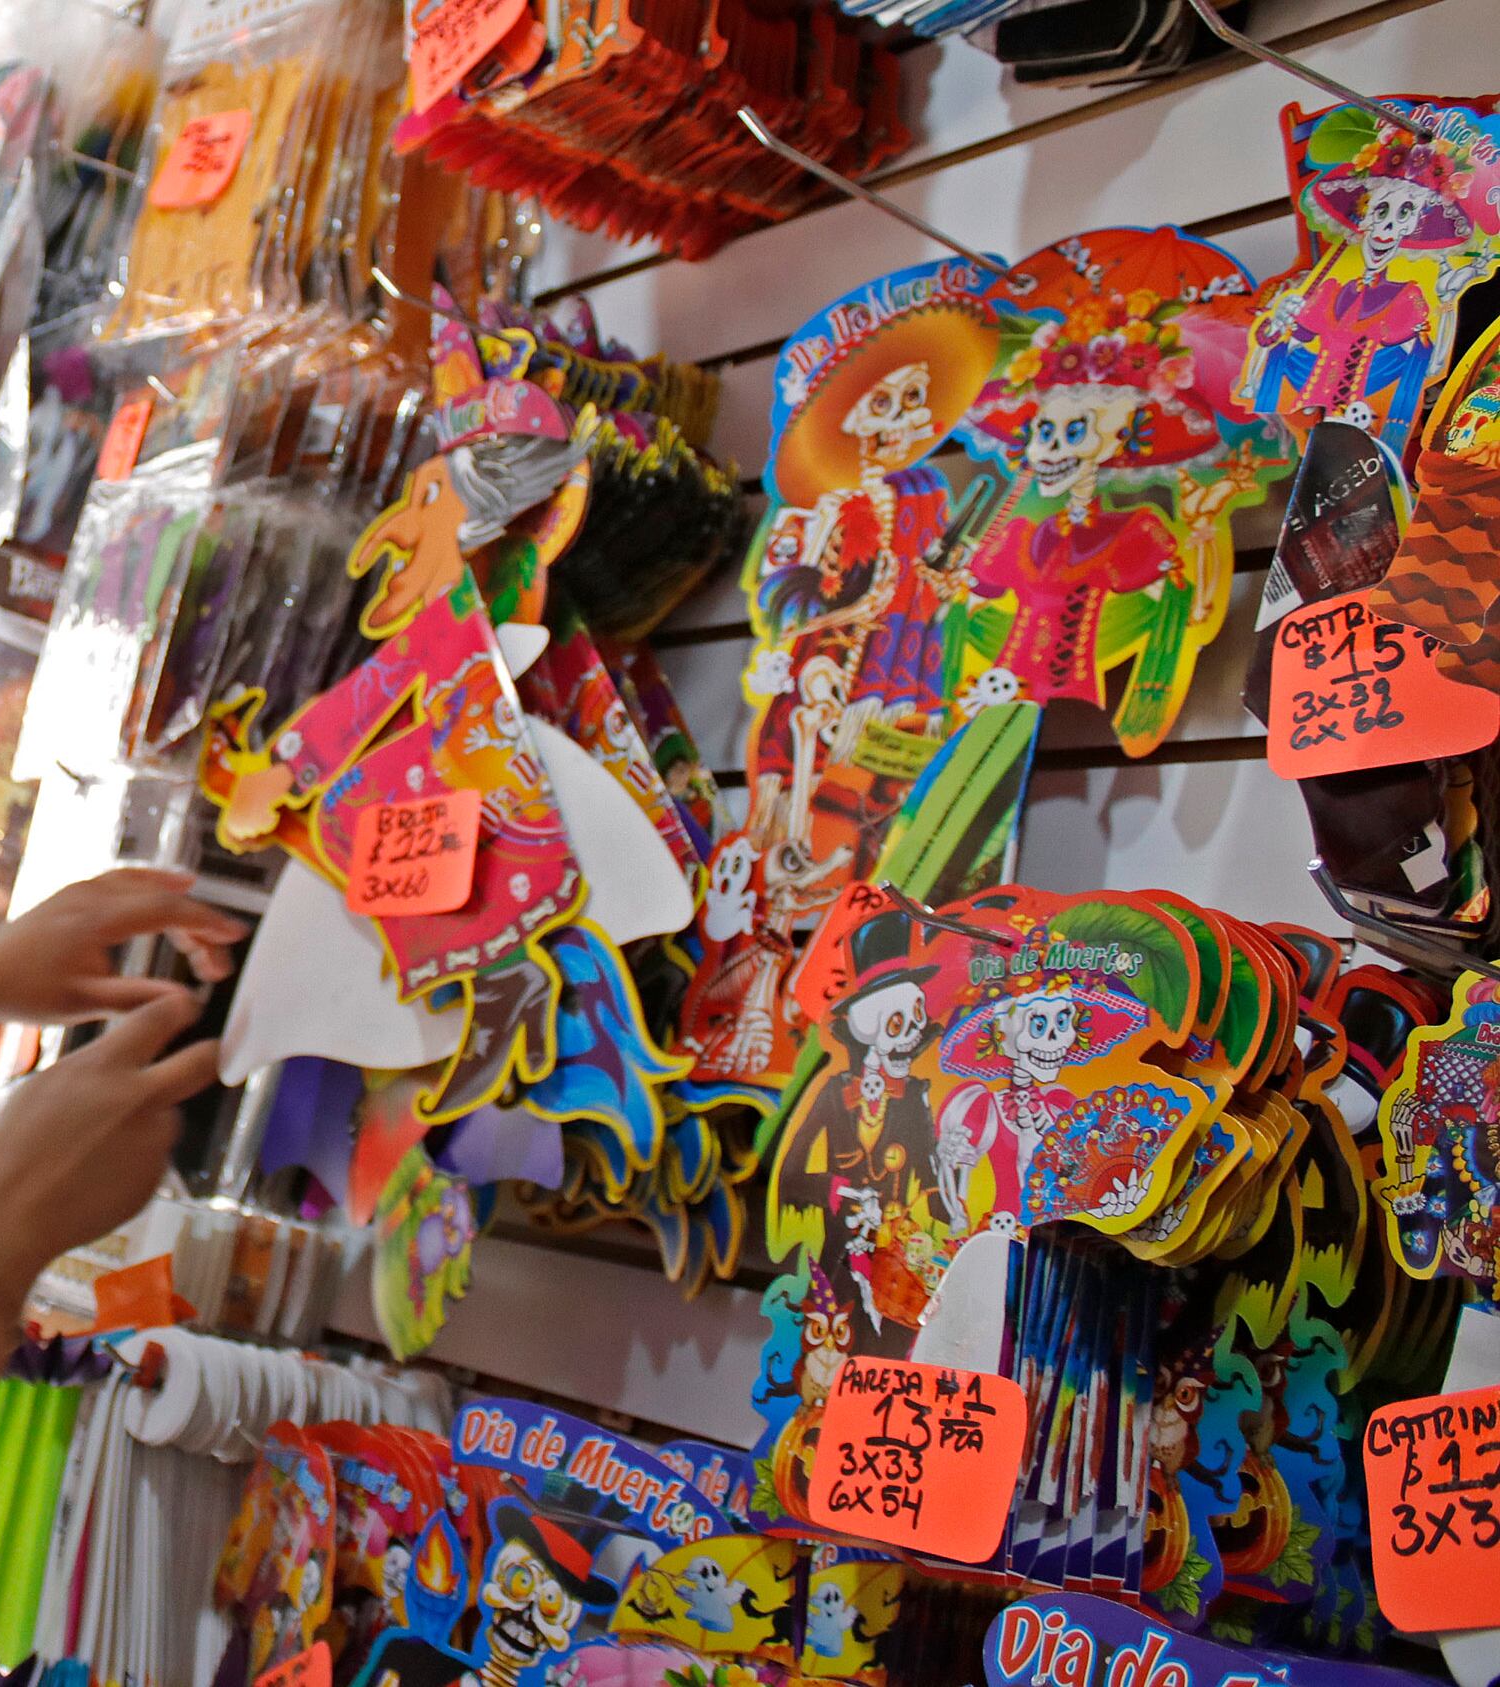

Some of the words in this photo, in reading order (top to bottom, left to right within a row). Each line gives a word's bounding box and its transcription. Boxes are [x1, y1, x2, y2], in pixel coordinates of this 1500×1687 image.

[1281, 601, 1383, 649] CATR
[1011, 943, 1040, 974] de
[1045, 940, 1143, 977] Muertos
[461, 1408, 516, 1460] Dia
[520, 1415, 566, 1470] de
[1367, 1405, 1500, 1457] CATRIN
[998, 1606, 1094, 1687] Dia
